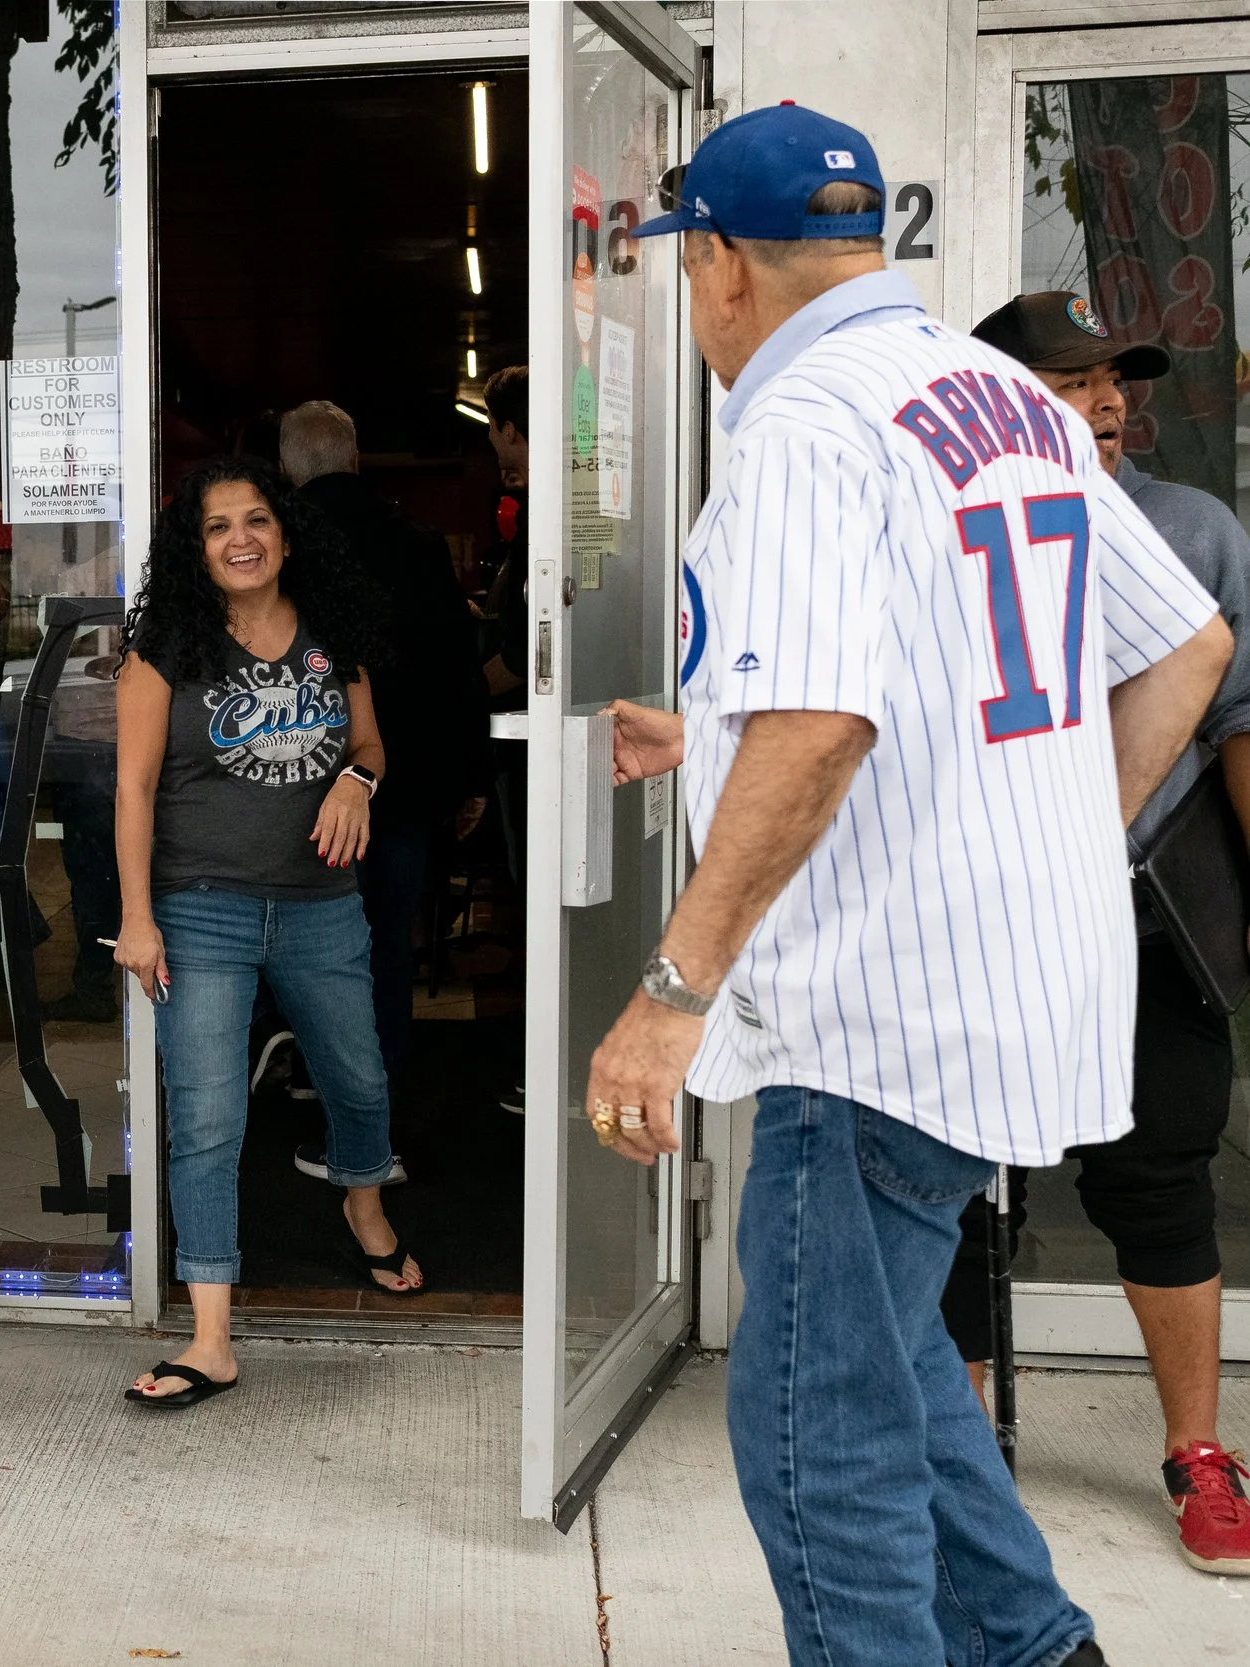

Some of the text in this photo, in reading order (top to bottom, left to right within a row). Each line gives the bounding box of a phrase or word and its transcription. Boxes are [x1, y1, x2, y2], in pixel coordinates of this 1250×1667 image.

[894, 183, 935, 261] 2
[11, 357, 115, 375] RESTROOM
[44, 378, 80, 392] FOR
[9, 393, 117, 411] CUSTOMERS
[40, 412, 86, 426] ONLY
[39, 443, 88, 461] BAÑO
[12, 463, 116, 479] PARA CLIENTES
[22, 482, 106, 498] SOLAMENTE
[30, 508, 80, 516] MANTENERLO
[81, 507, 106, 515] LIMPIO
[954, 492, 1090, 744] 17
[209, 683, 348, 748] Cubs
[214, 736, 346, 785] BASEBALL
